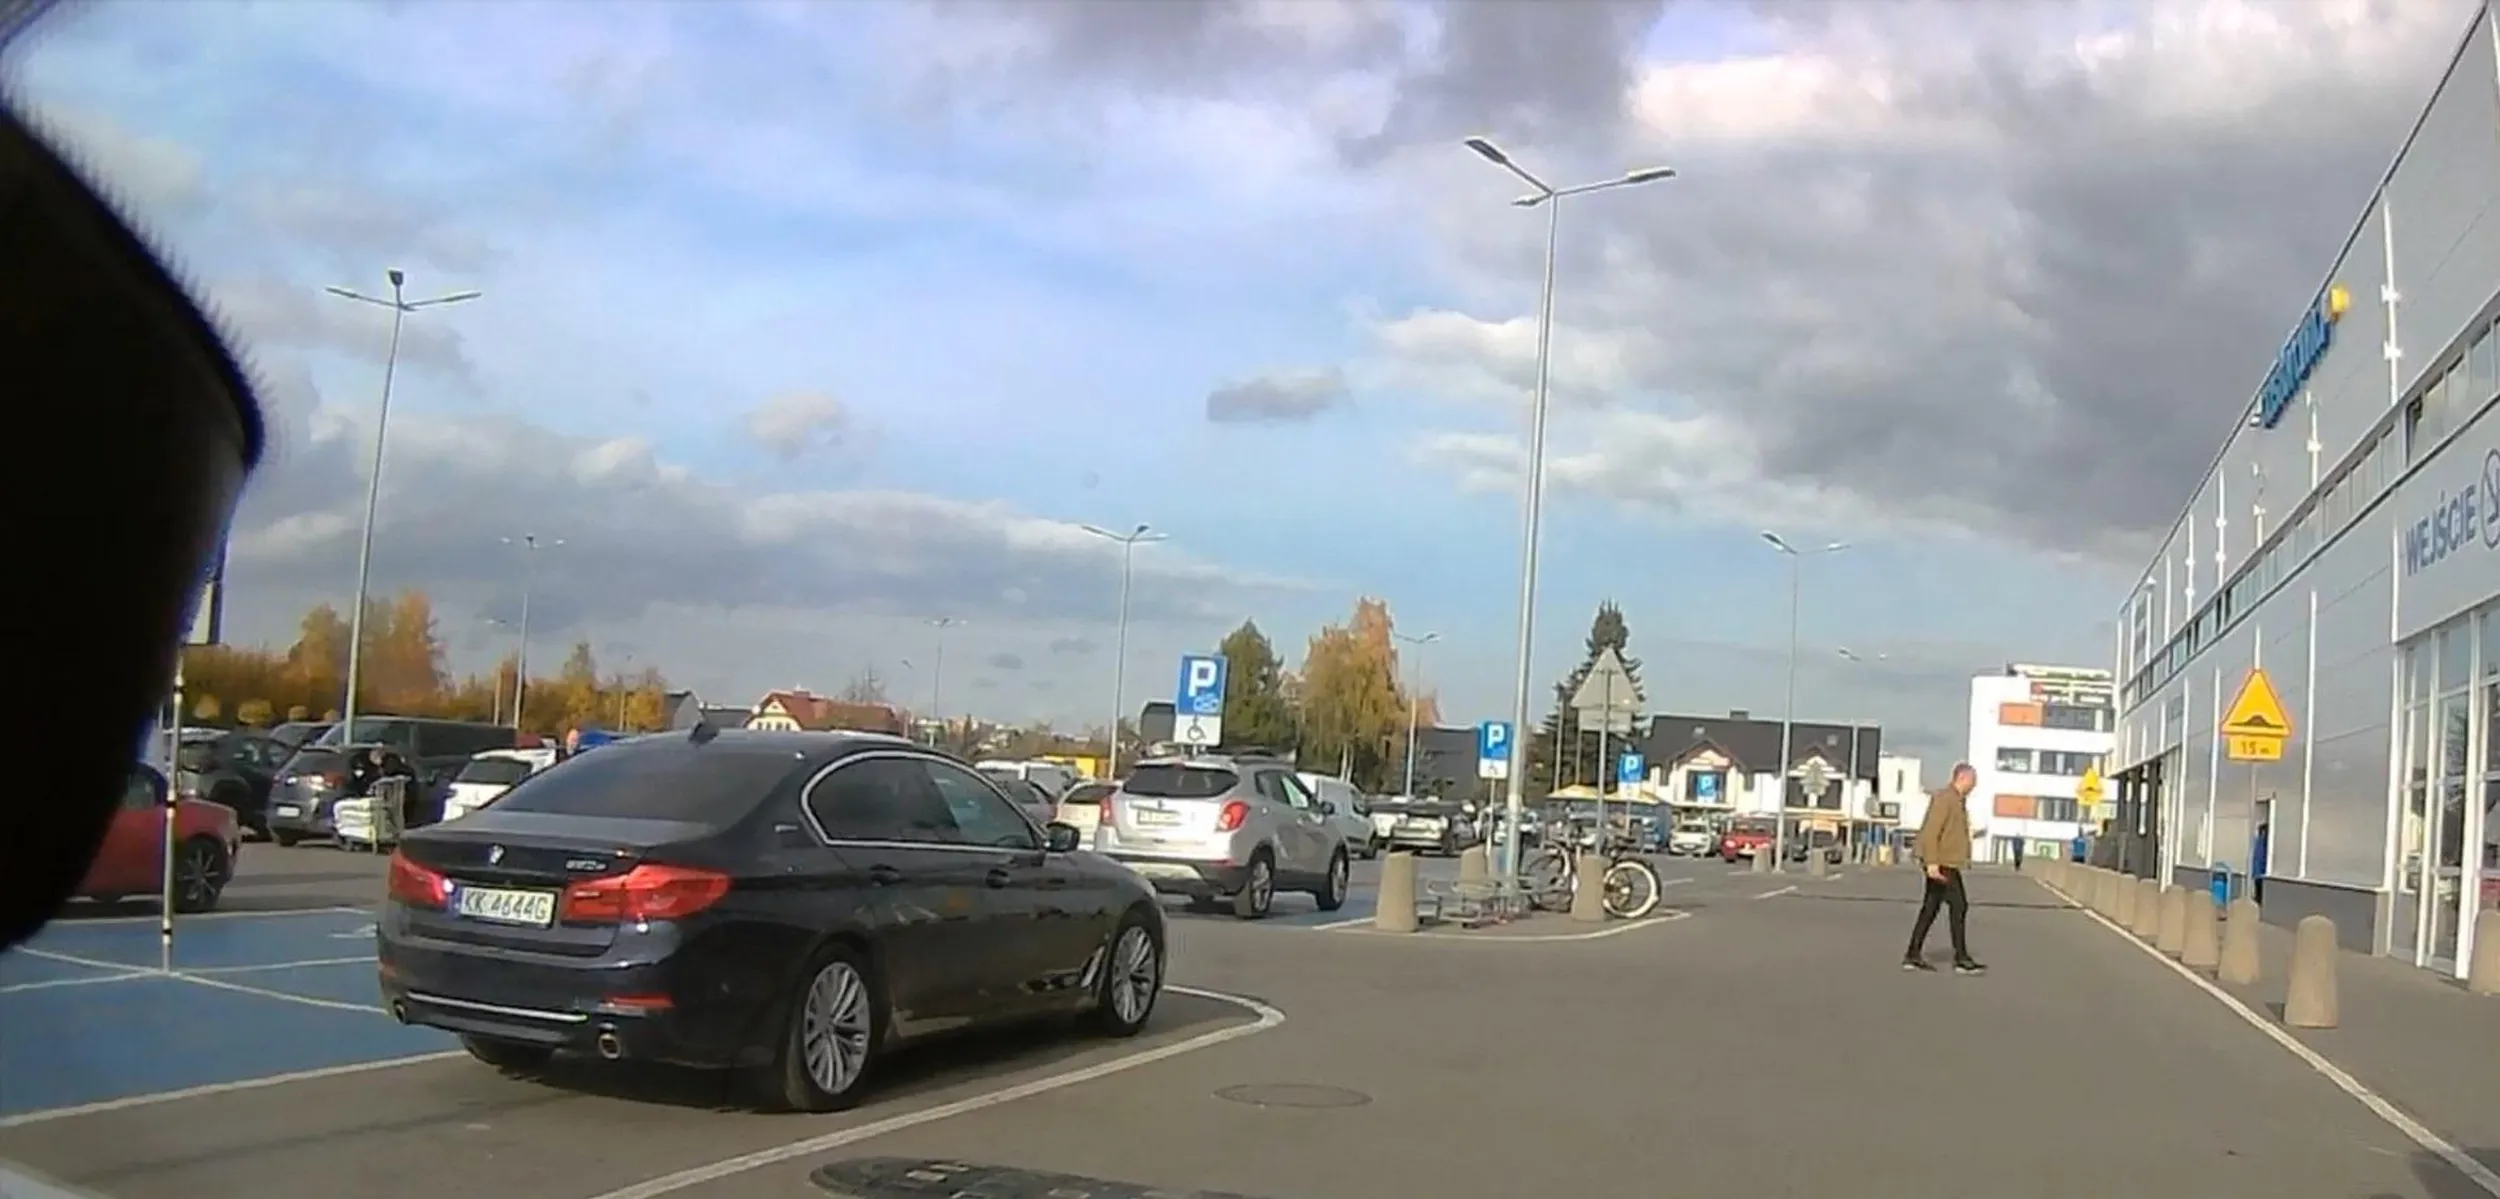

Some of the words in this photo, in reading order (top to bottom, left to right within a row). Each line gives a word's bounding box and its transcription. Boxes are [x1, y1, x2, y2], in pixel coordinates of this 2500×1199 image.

[2405, 484, 2476, 577] WEJŚCIE
[1188, 660, 1217, 697] P
[1487, 723, 1505, 749] P
[2241, 741, 2257, 755] 15
[1624, 755, 1639, 775] P
[1701, 775, 1713, 790] P
[464, 889, 487, 913] KK
